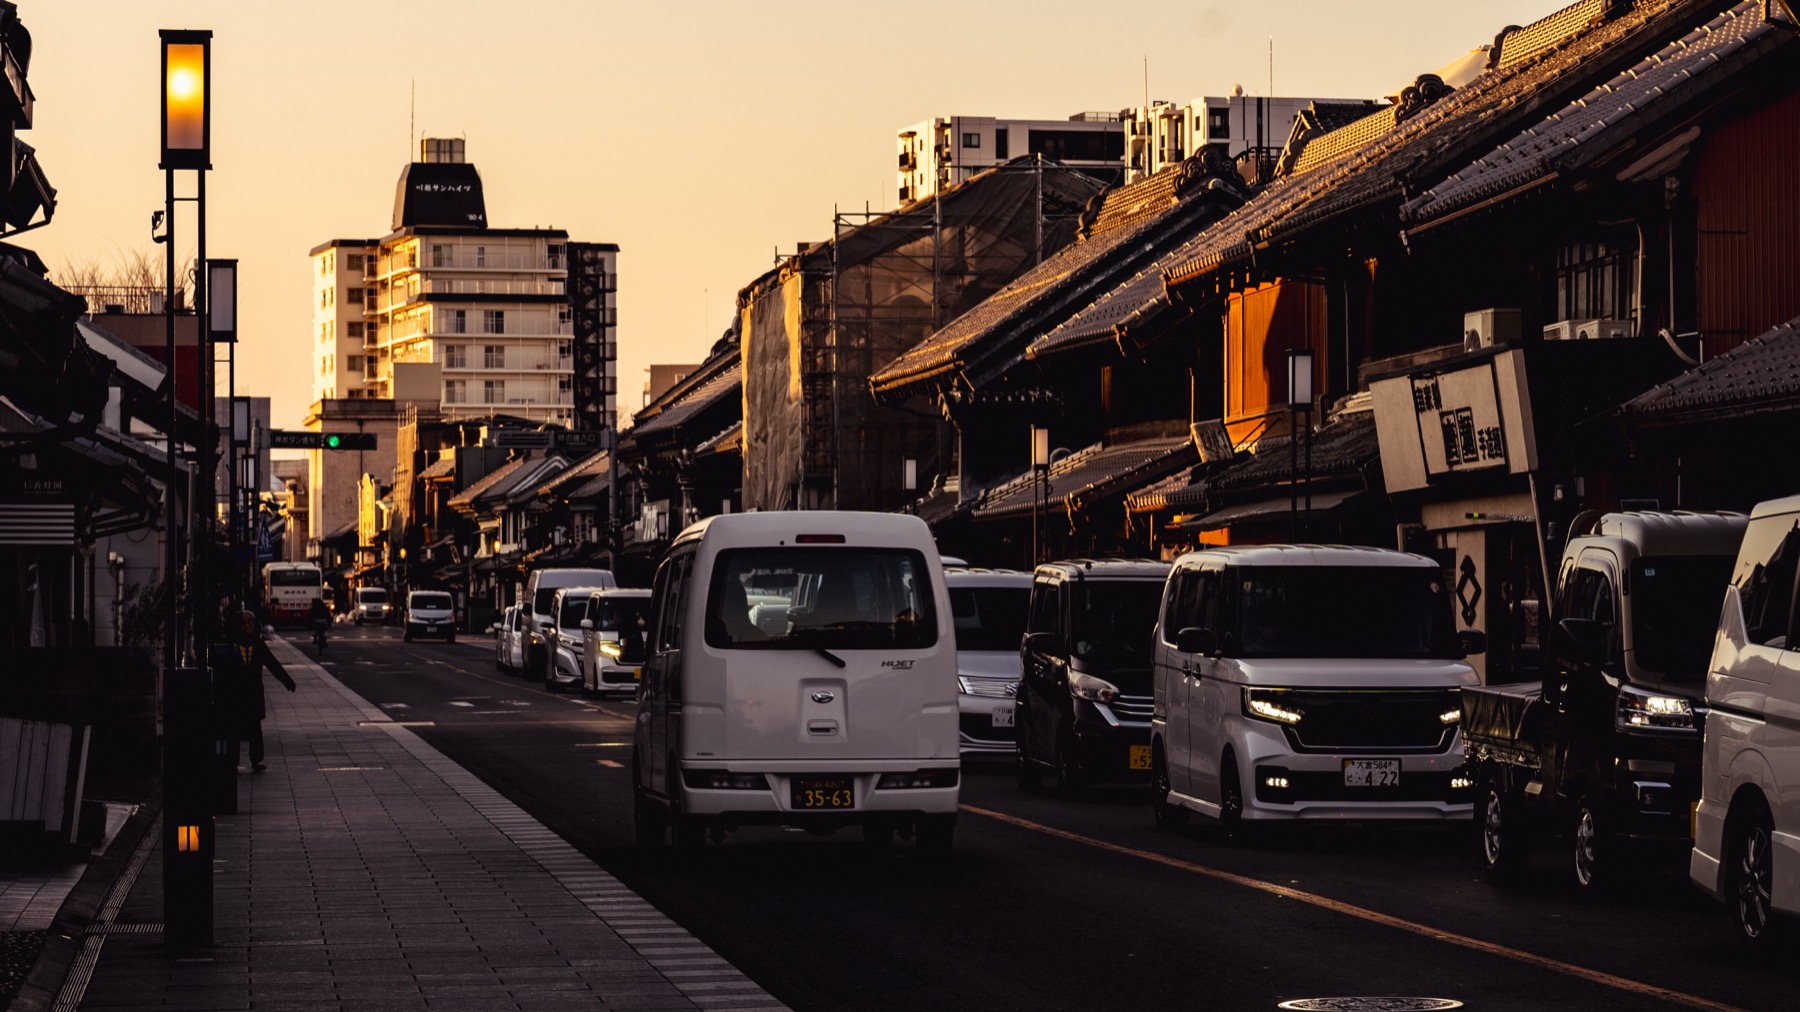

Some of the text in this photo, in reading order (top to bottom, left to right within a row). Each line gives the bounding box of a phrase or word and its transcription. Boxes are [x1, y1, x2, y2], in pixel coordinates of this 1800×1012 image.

[415, 184, 471, 192] 川越サンハイツ
[805, 790, 852, 807] 35-63
